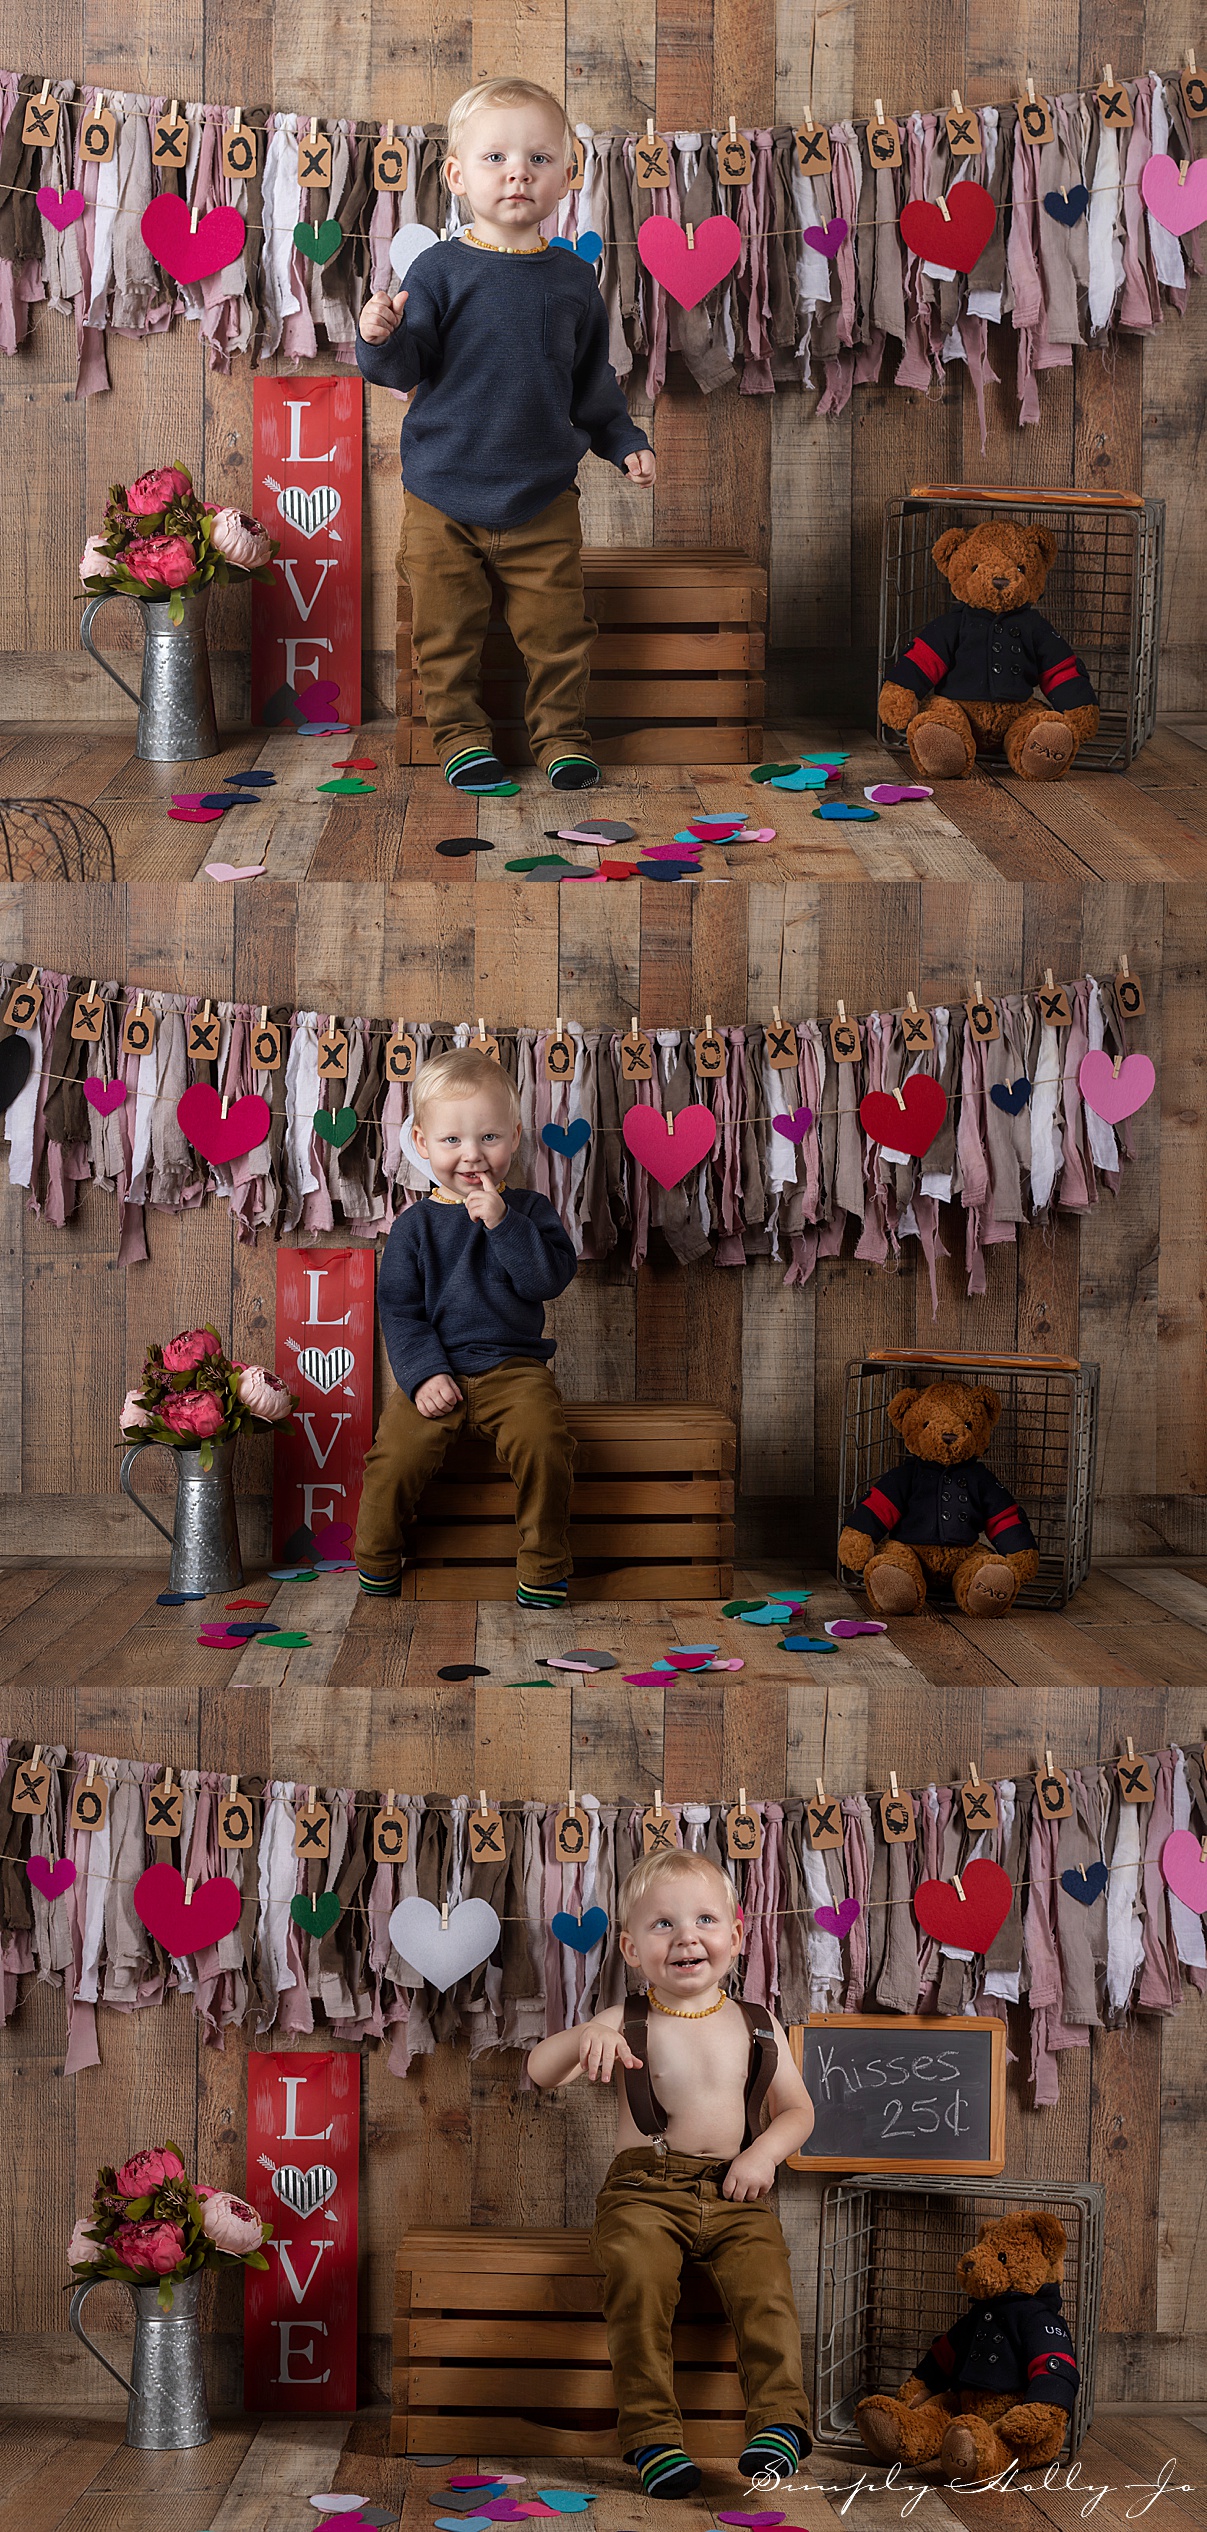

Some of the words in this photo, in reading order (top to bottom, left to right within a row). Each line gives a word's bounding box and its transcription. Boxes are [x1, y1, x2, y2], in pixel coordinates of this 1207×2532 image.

[26, 106, 53, 137] X
[85, 125, 109, 155] O
[155, 129, 183, 156] X
[228, 141, 253, 171] O
[301, 149, 328, 177] X
[379, 150, 403, 184] O
[639, 148, 667, 178] X
[724, 142, 746, 177] O
[799, 136, 826, 164] X
[872, 132, 894, 161] O
[949, 120, 974, 144] X
[1023, 107, 1045, 137] O
[1099, 92, 1127, 119] X
[1186, 81, 1207, 112] O
[12, 995, 35, 1023] O
[75, 1006, 100, 1032] X
[127, 1021, 149, 1049] O
[190, 1025, 216, 1050] X
[255, 1035, 278, 1063] O
[320, 1044, 345, 1069] X
[390, 1046, 411, 1075] O
[547, 1042, 570, 1073] O
[624, 1046, 650, 1071] X
[700, 1041, 721, 1070] O
[768, 1033, 794, 1058] X
[834, 1027, 855, 1057] O
[904, 1019, 927, 1041] X
[972, 1006, 992, 1035] O
[1041, 993, 1066, 1018] X
[1120, 985, 1140, 1012] O
[16, 1775, 45, 1805] X
[76, 1792, 102, 1824] O
[149, 1797, 178, 1826] X
[223, 1809, 249, 1841] O
[298, 1821, 325, 1847] X
[378, 1824, 402, 1855] O
[473, 1823, 501, 1852] X
[559, 1818, 584, 1853] O
[645, 1820, 675, 1850] X
[733, 1816, 755, 1851] O
[810, 1808, 839, 1837] X
[885, 1802, 908, 1836] O
[965, 1793, 991, 1819] X
[1041, 1780, 1064, 1812] O
[1120, 1767, 1148, 1793] X
[817, 2045, 961, 2100] Kisses
[880, 2088, 970, 2138] 25¢
